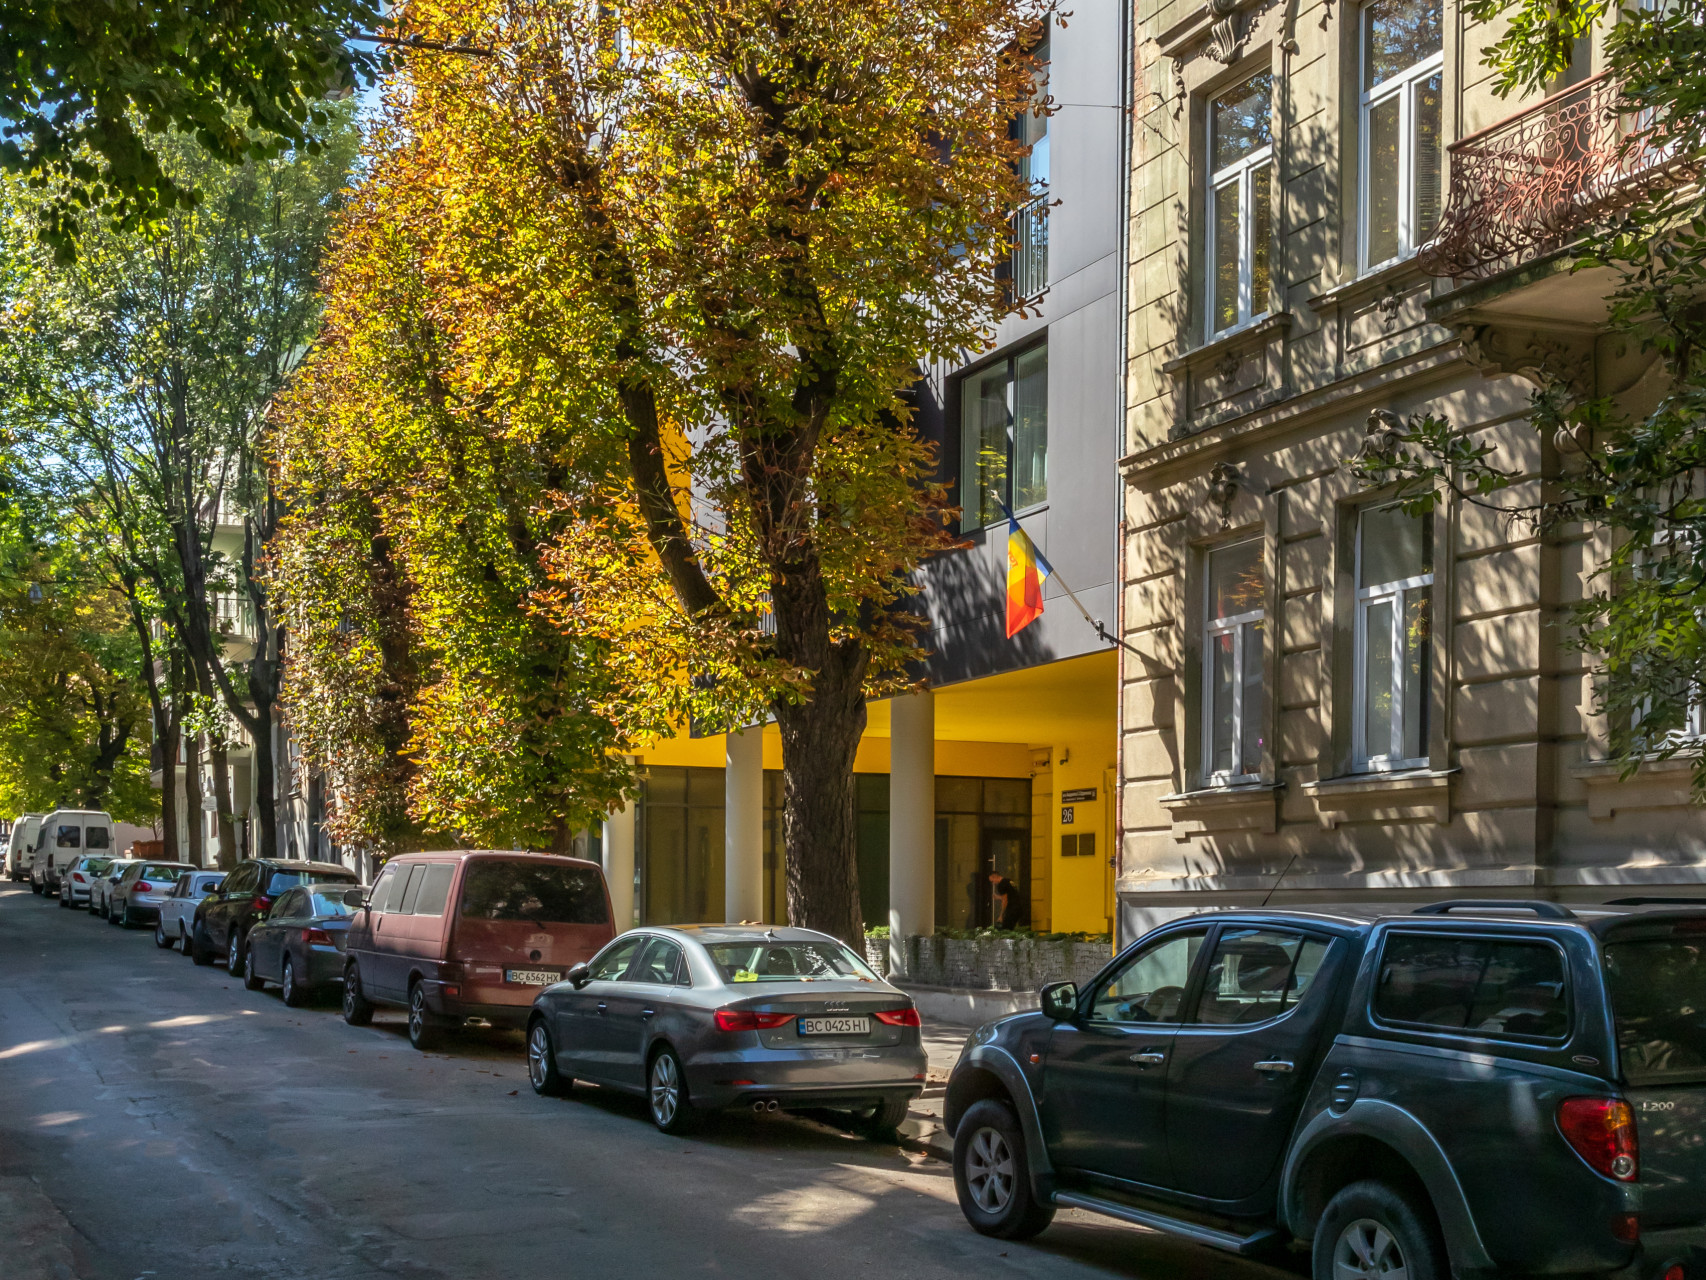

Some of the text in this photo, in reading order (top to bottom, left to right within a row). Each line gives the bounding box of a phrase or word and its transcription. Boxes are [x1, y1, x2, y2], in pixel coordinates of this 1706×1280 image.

[1062, 808, 1073, 823] 26
[512, 971, 559, 983] BC 6562 HX
[806, 1020, 823, 1032] BC
[825, 1020, 851, 1032] 0425
[853, 1019, 866, 1031] HI
